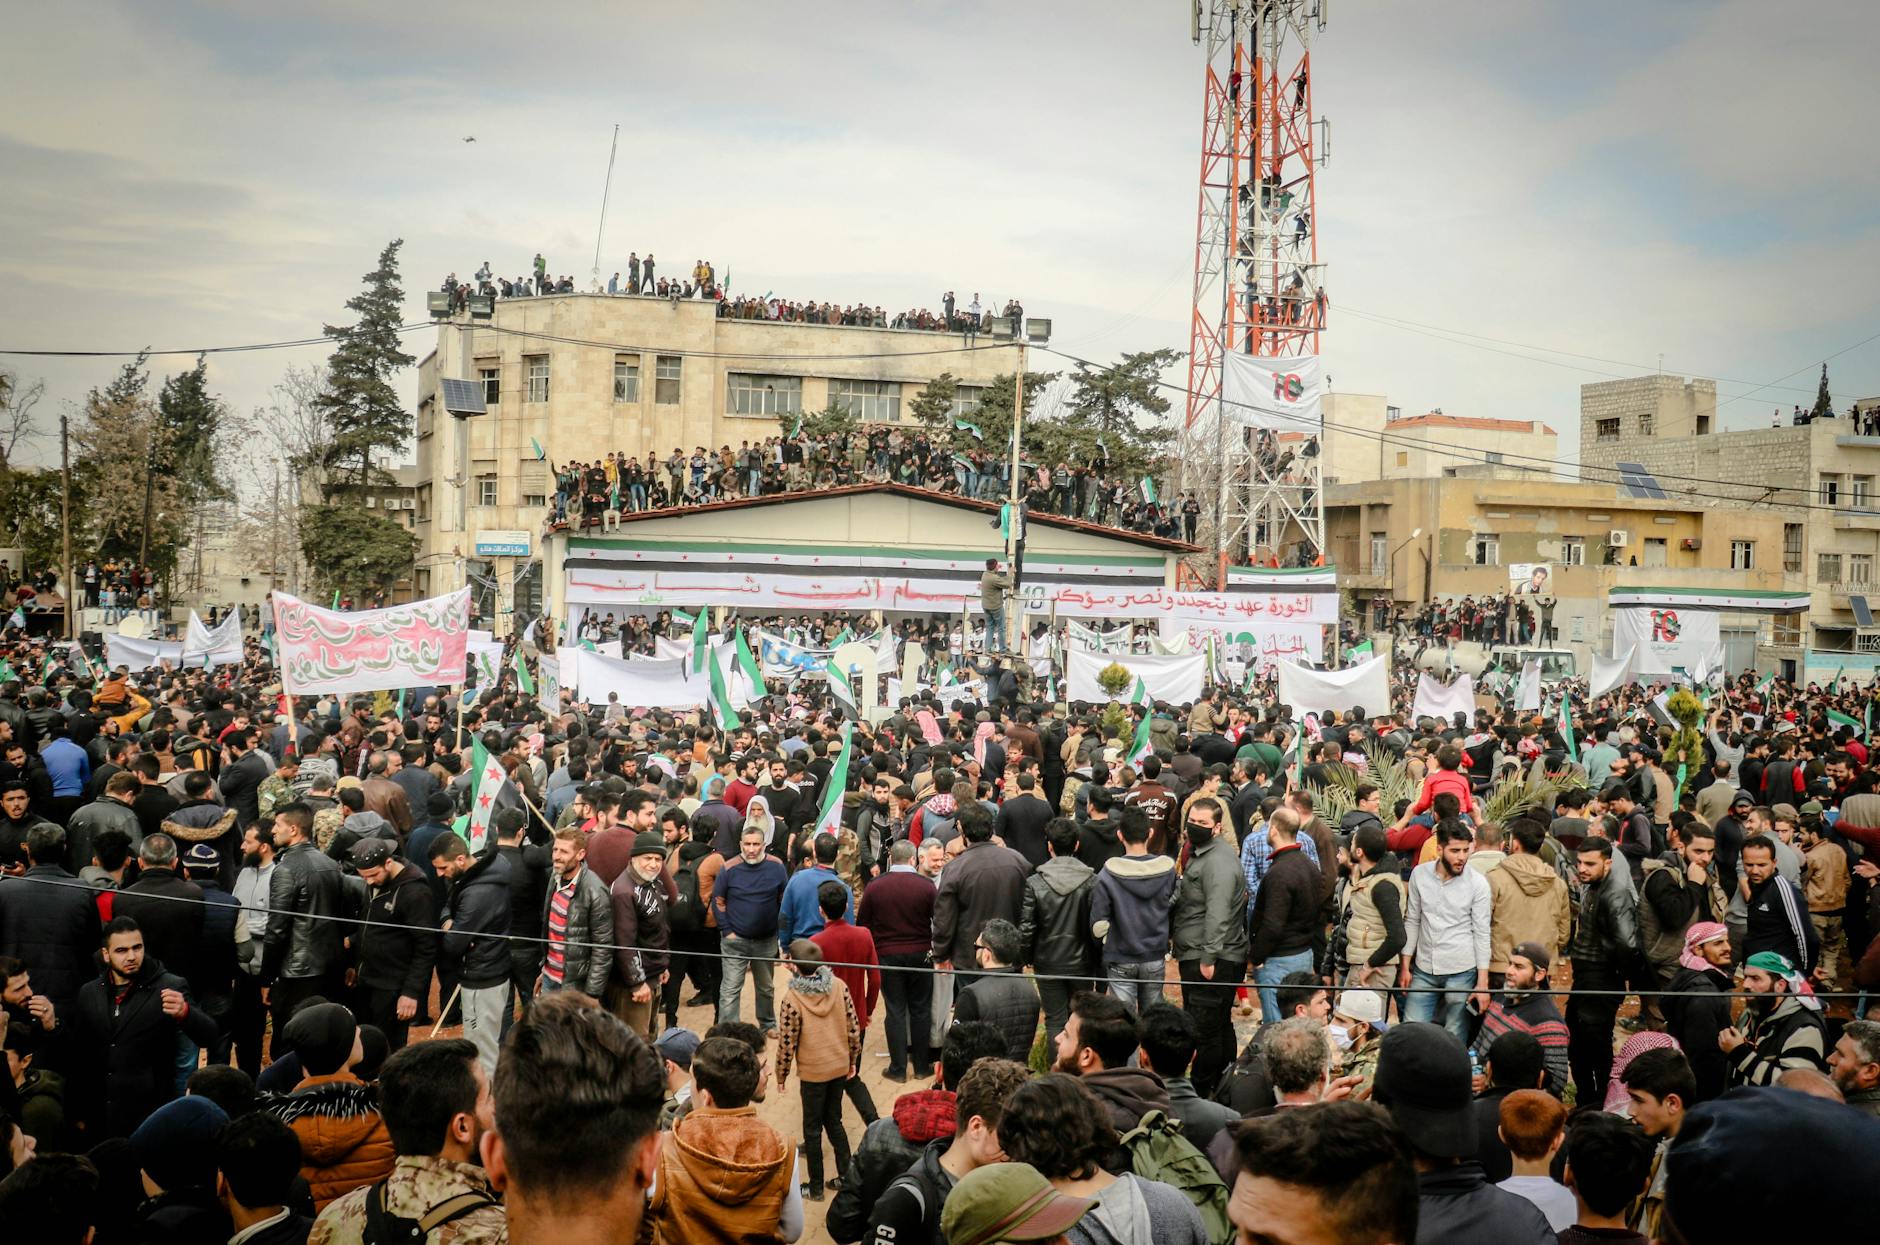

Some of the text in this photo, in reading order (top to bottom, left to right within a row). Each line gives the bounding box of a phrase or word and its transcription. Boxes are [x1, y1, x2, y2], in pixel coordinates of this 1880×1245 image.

[1177, 595, 1228, 617] يتجدد
[1234, 598, 1264, 617] عهد
[1269, 594, 1313, 618] الثورة
